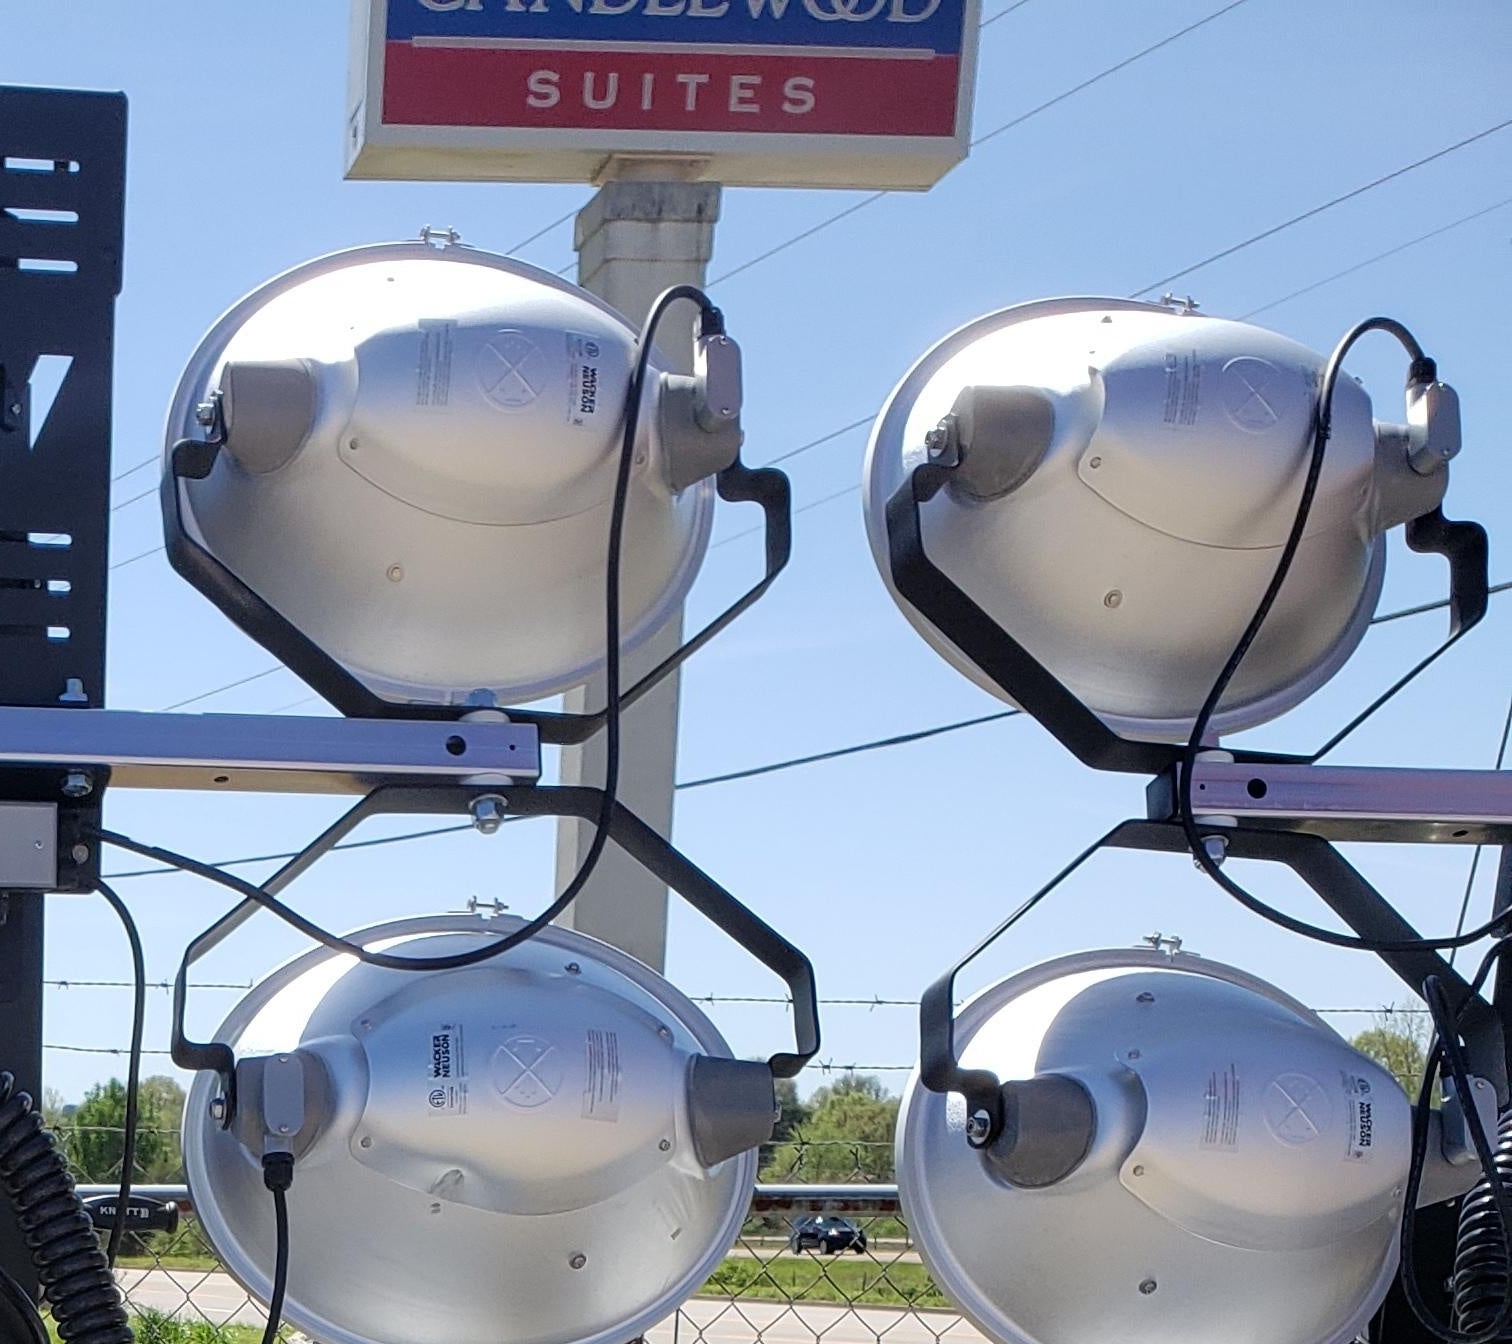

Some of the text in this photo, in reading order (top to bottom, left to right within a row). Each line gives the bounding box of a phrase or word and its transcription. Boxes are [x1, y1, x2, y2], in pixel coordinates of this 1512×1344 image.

[526, 69, 816, 114] SUITES
[442, 1033, 451, 1078] NEUSON
[1358, 1101, 1367, 1147] NEUSON
[99, 1206, 139, 1215] KNTT
